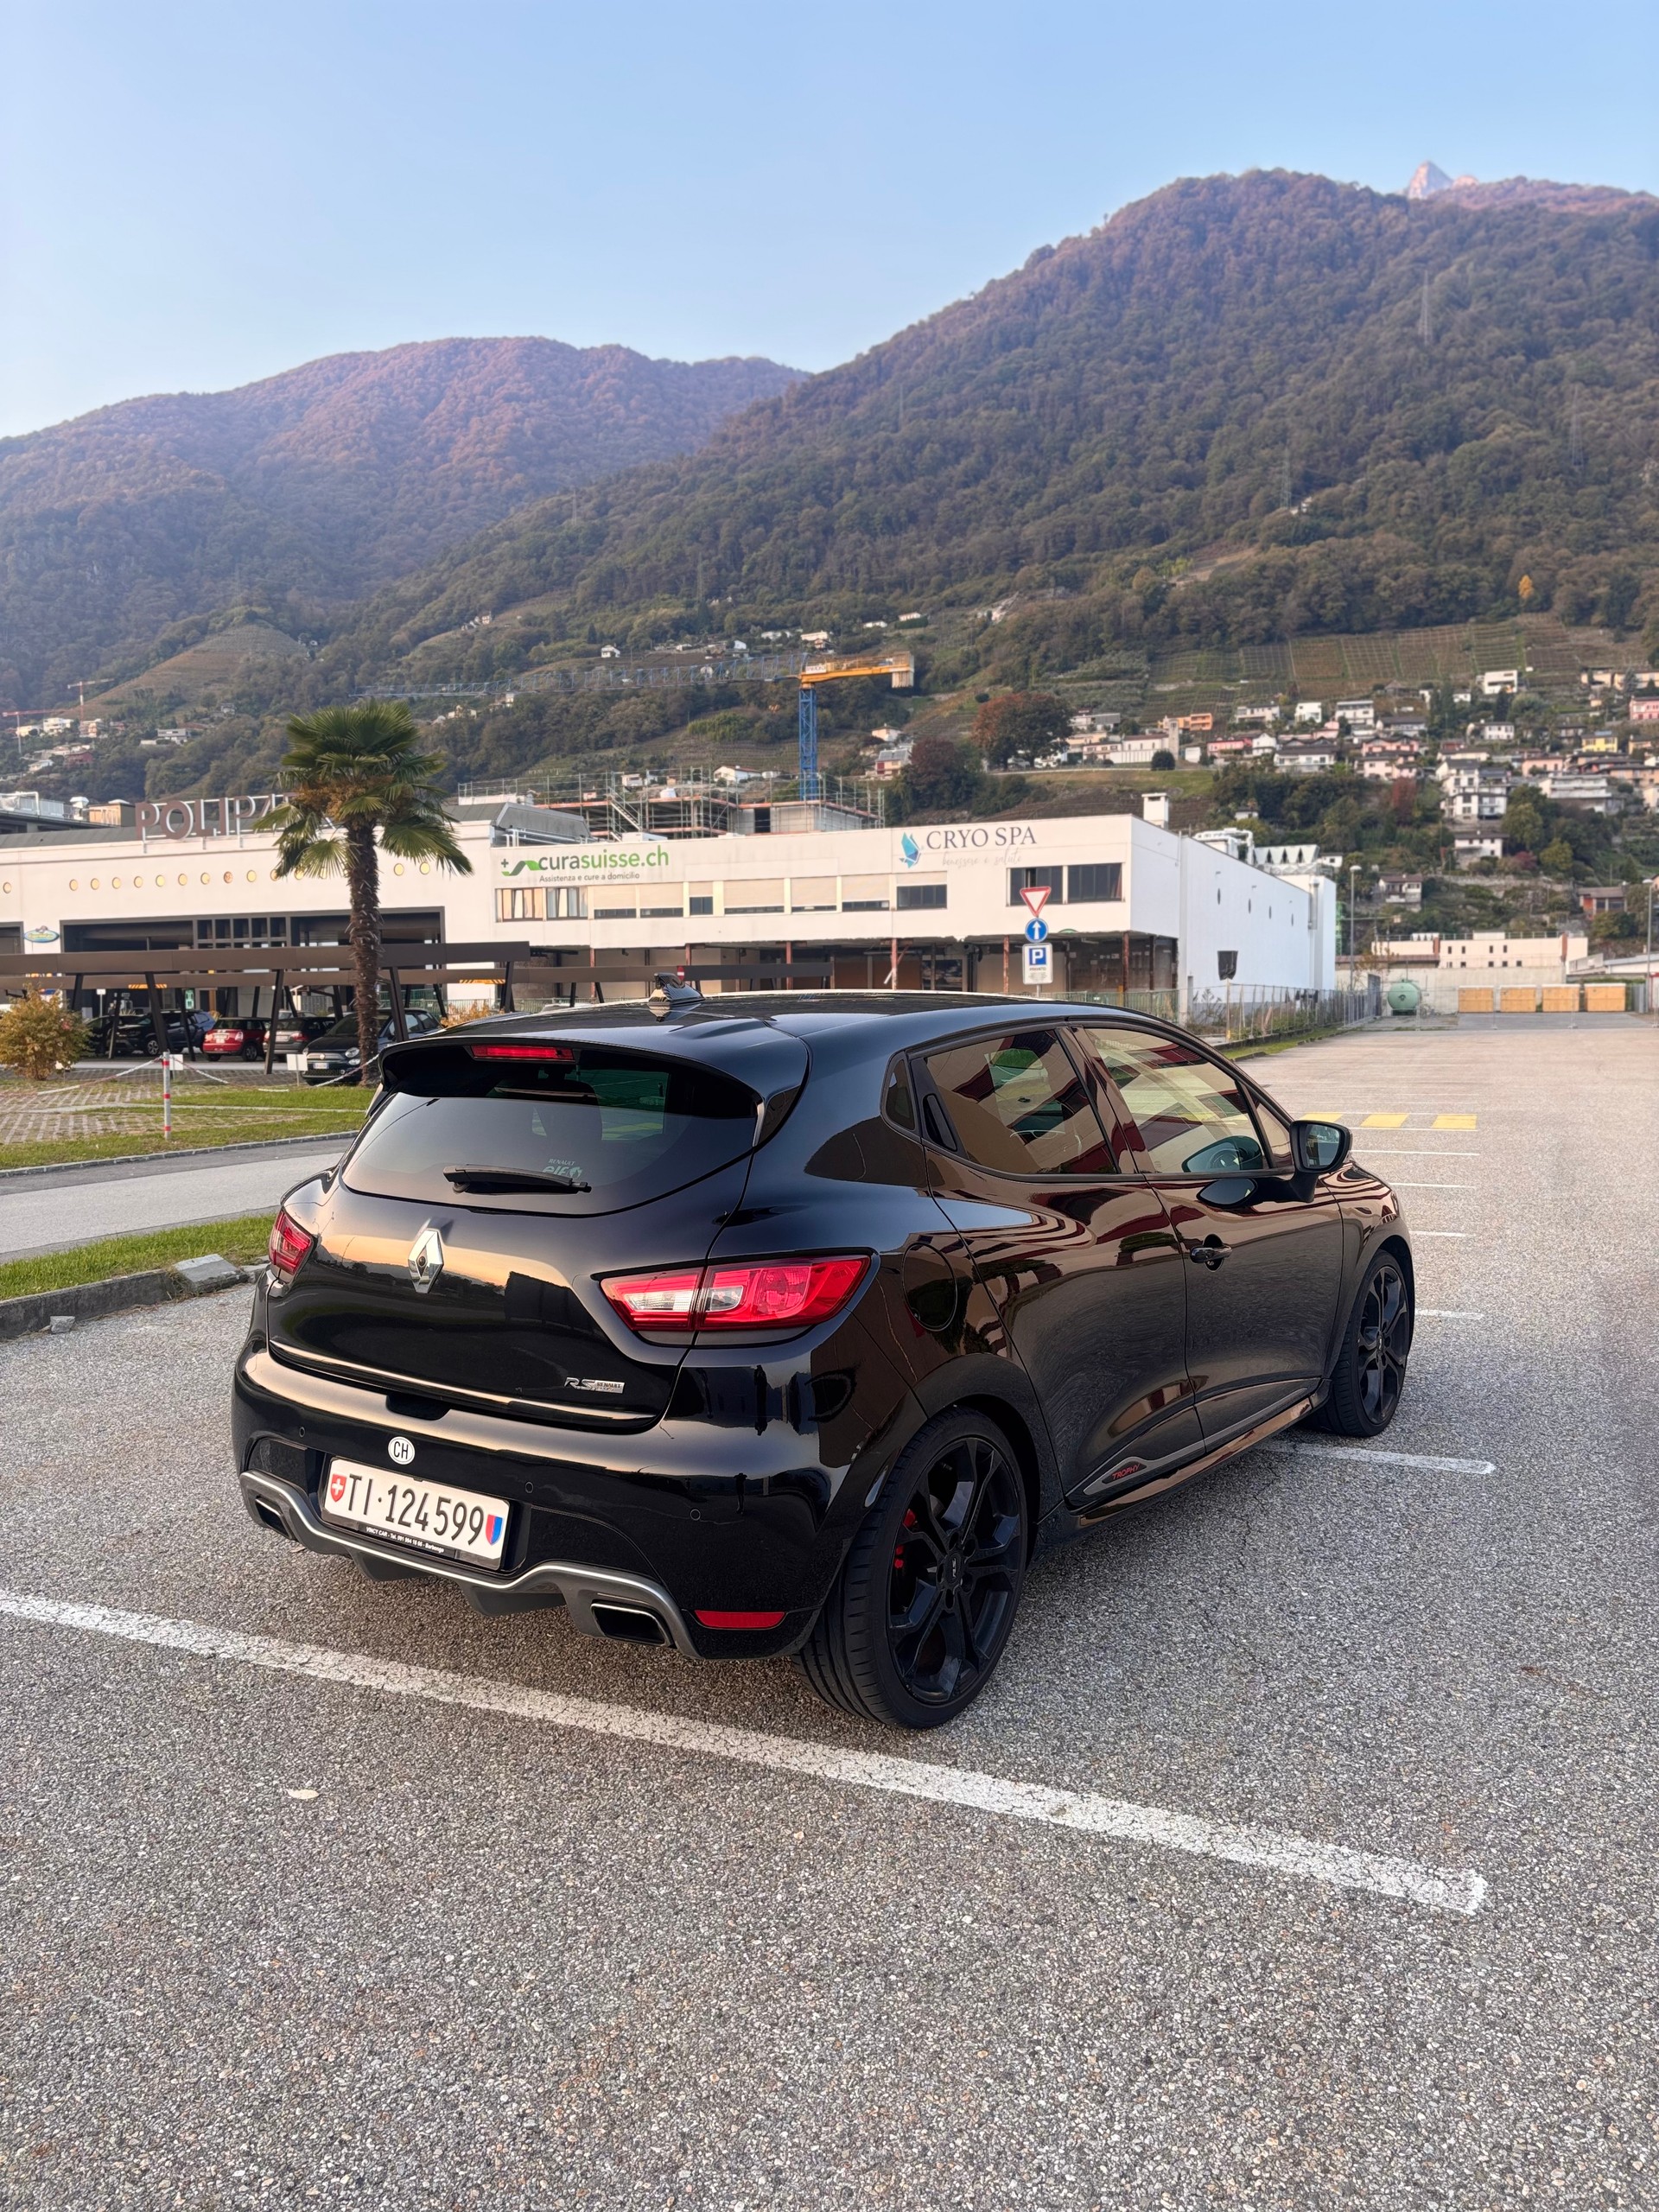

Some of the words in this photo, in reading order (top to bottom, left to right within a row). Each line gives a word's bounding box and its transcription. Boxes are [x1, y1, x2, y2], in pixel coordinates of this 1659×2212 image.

[926, 828, 988, 850] CRYO
[995, 825, 1037, 847] SPA
[539, 845, 669, 870] curasuisse.ch
[539, 874, 575, 883] Assistenza
[607, 871, 640, 880] domicilio
[1032, 949, 1044, 964] P
[393, 1440, 410, 1460] CH
[1112, 1463, 1140, 1479] TROPHY
